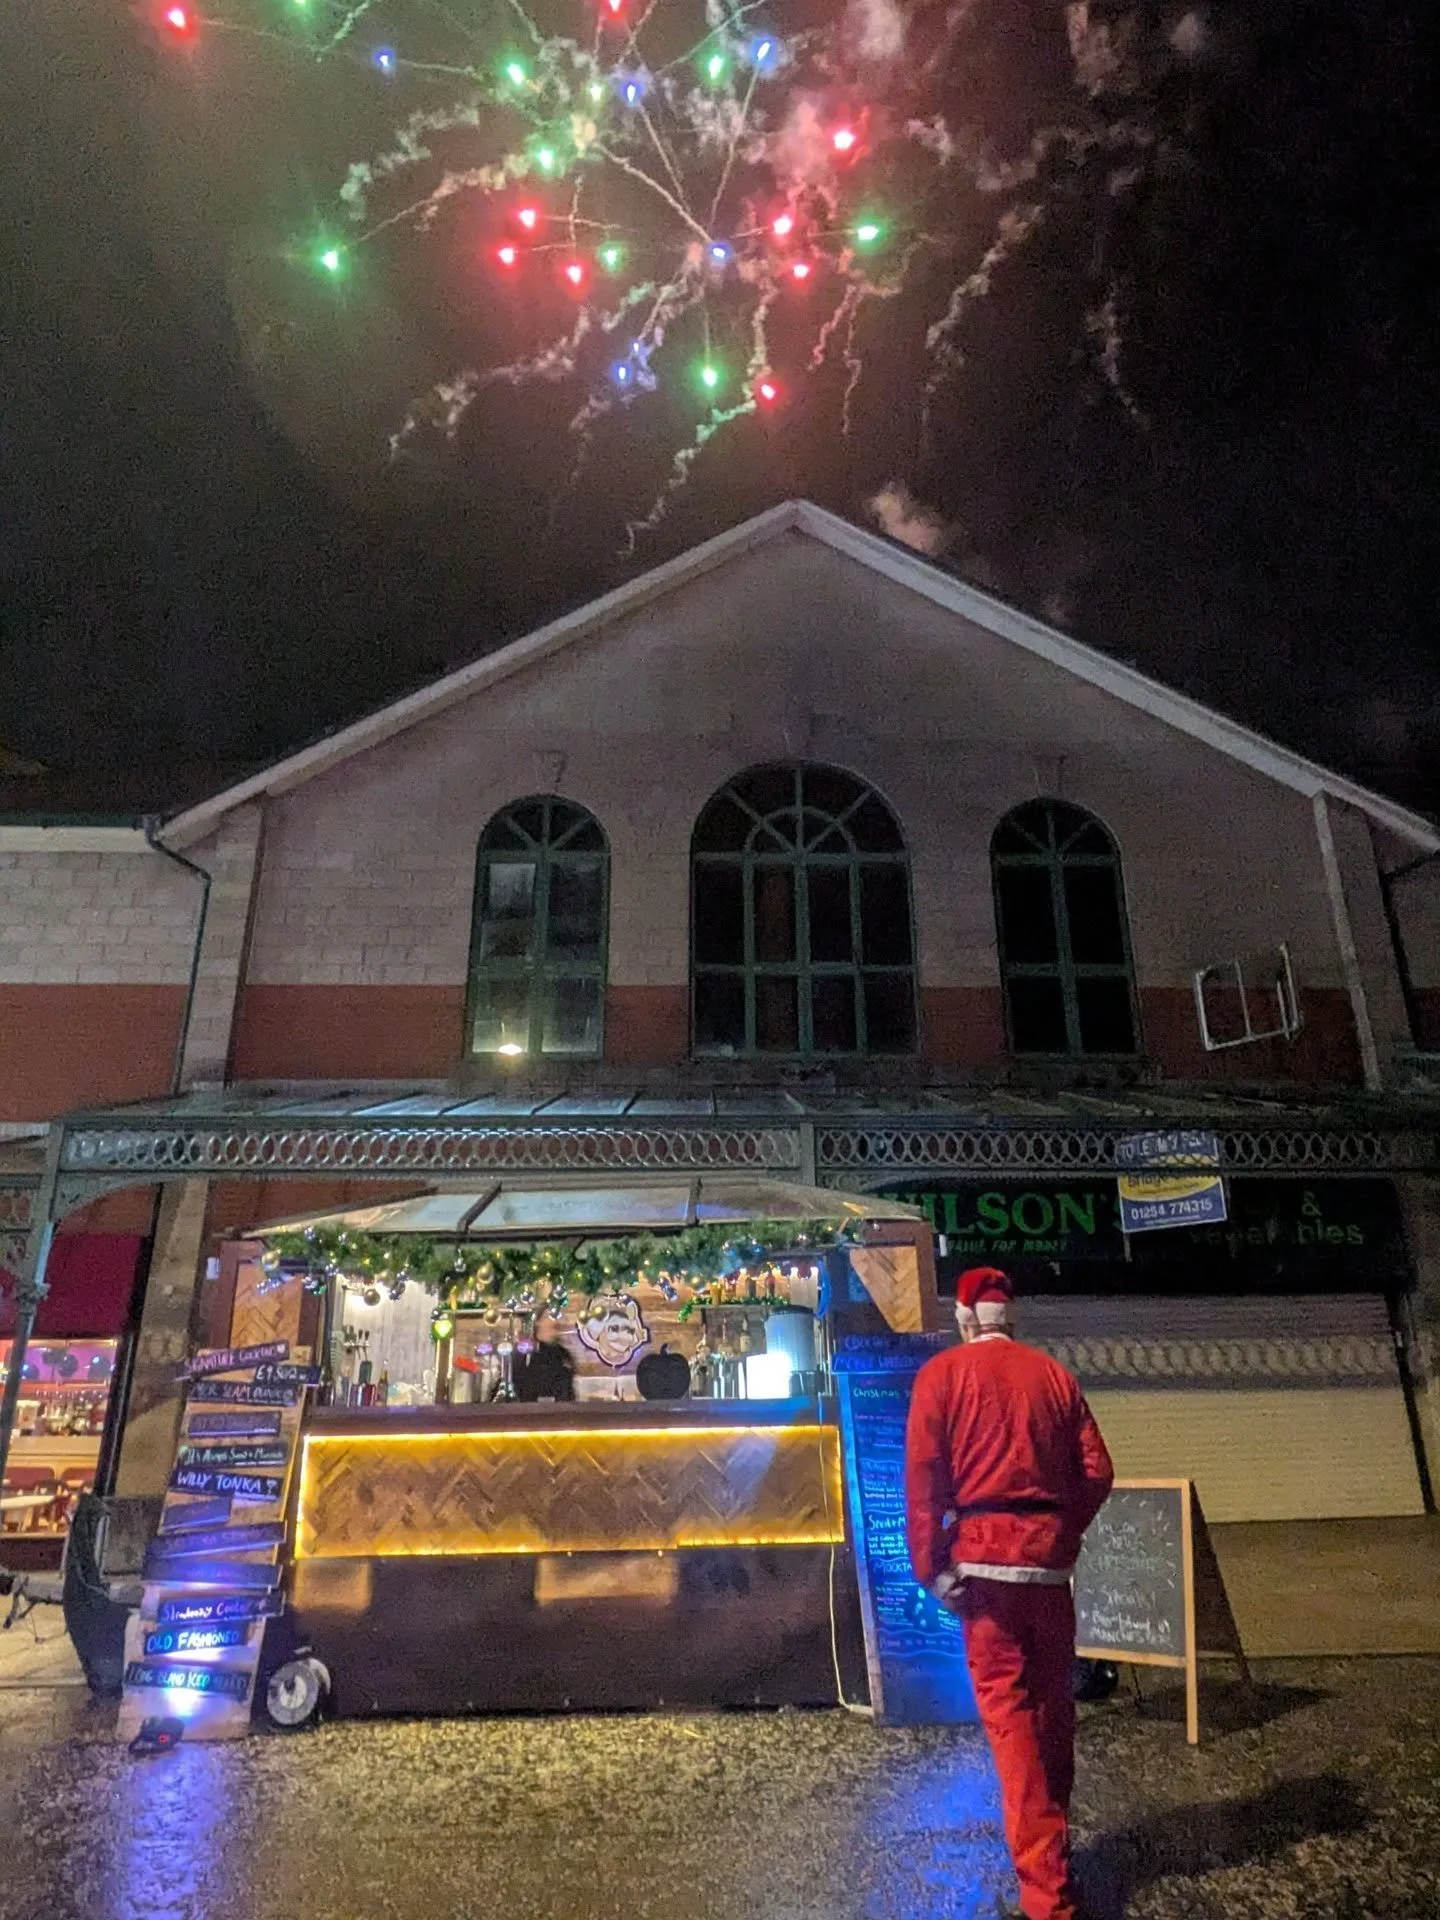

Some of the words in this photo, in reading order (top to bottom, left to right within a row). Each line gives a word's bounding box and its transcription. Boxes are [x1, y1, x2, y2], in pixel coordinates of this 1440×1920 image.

[885, 1192, 1120, 1236] ILSON'
[1130, 1204, 1165, 1220] 01254
[1169, 1198, 1213, 1215] 774315
[177, 1471, 212, 1488] WILLY
[216, 1474, 261, 1493] TONKA
[874, 1562, 912, 1574] MOCKTA
[147, 1635, 173, 1652] OLD
